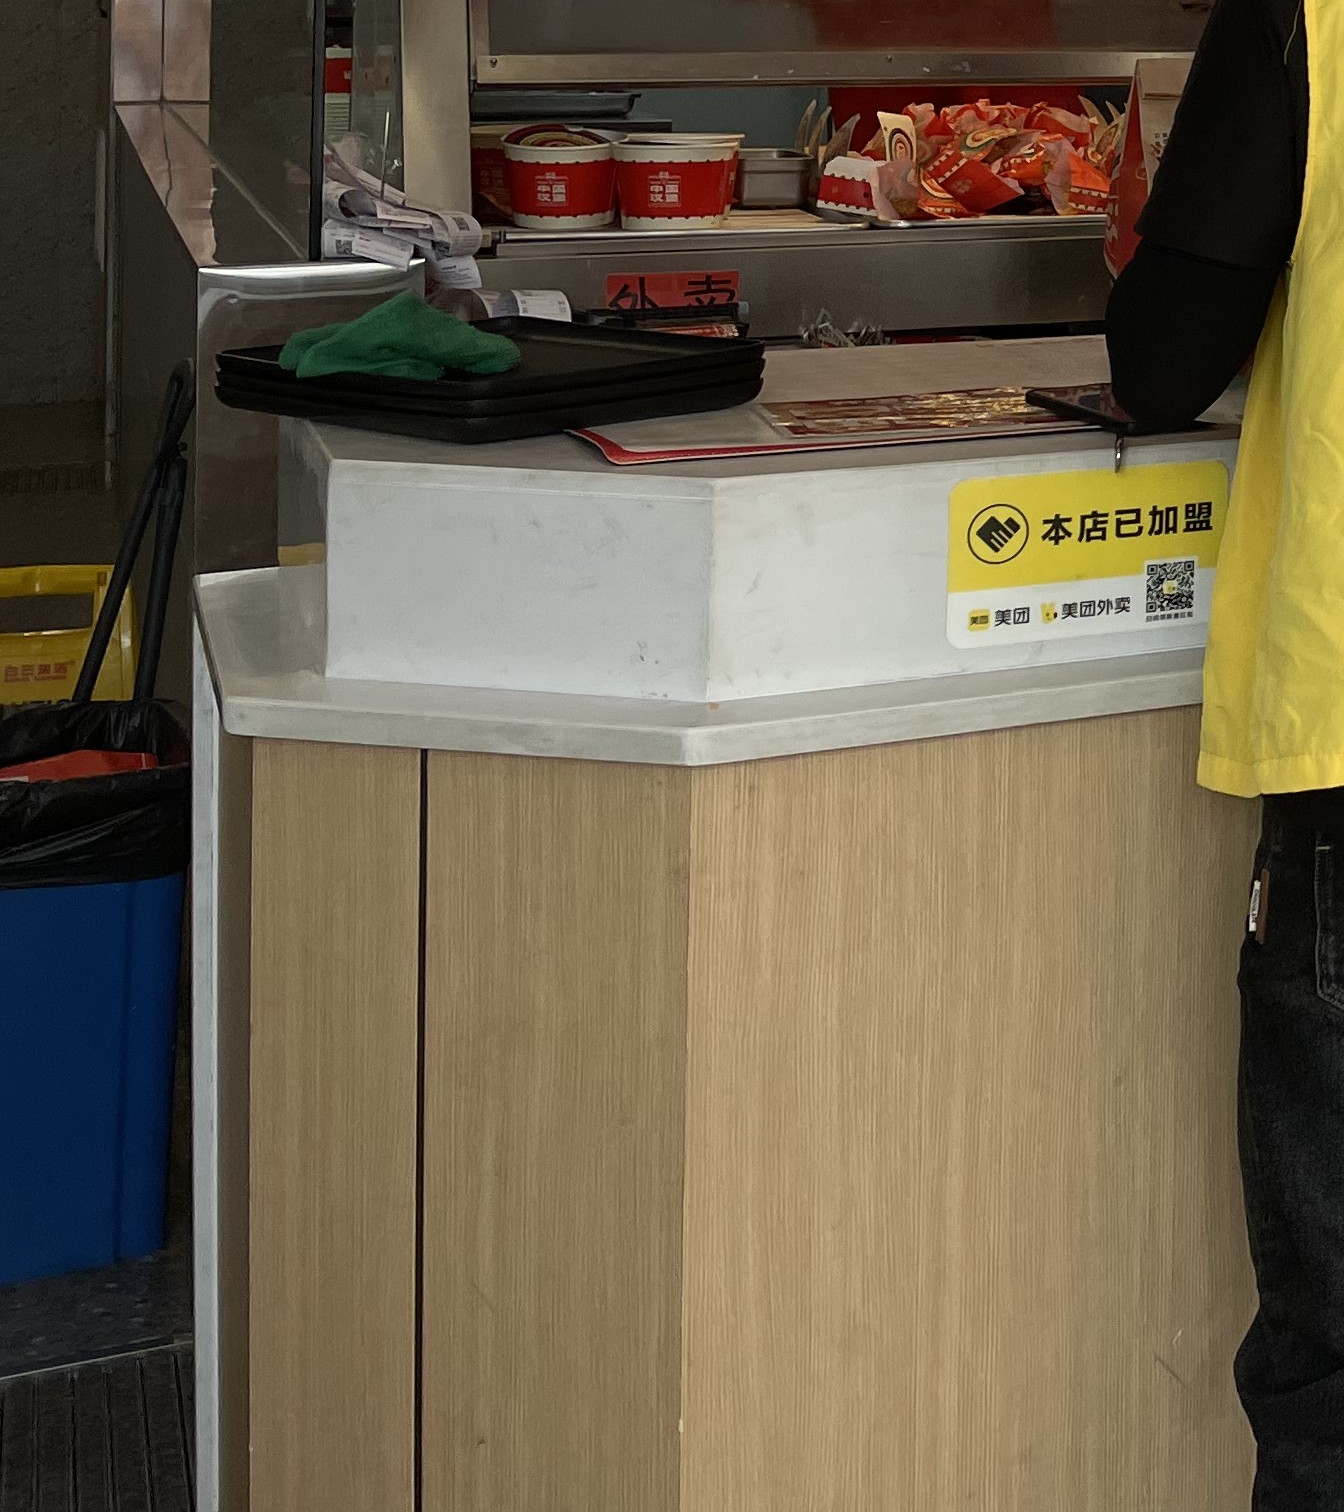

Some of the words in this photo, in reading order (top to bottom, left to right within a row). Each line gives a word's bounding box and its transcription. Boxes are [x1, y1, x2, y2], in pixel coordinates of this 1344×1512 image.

[1041, 501, 1213, 546] 本店已加盟
[994, 607, 1030, 627] 美团
[1061, 596, 1131, 620] 美团外卖
